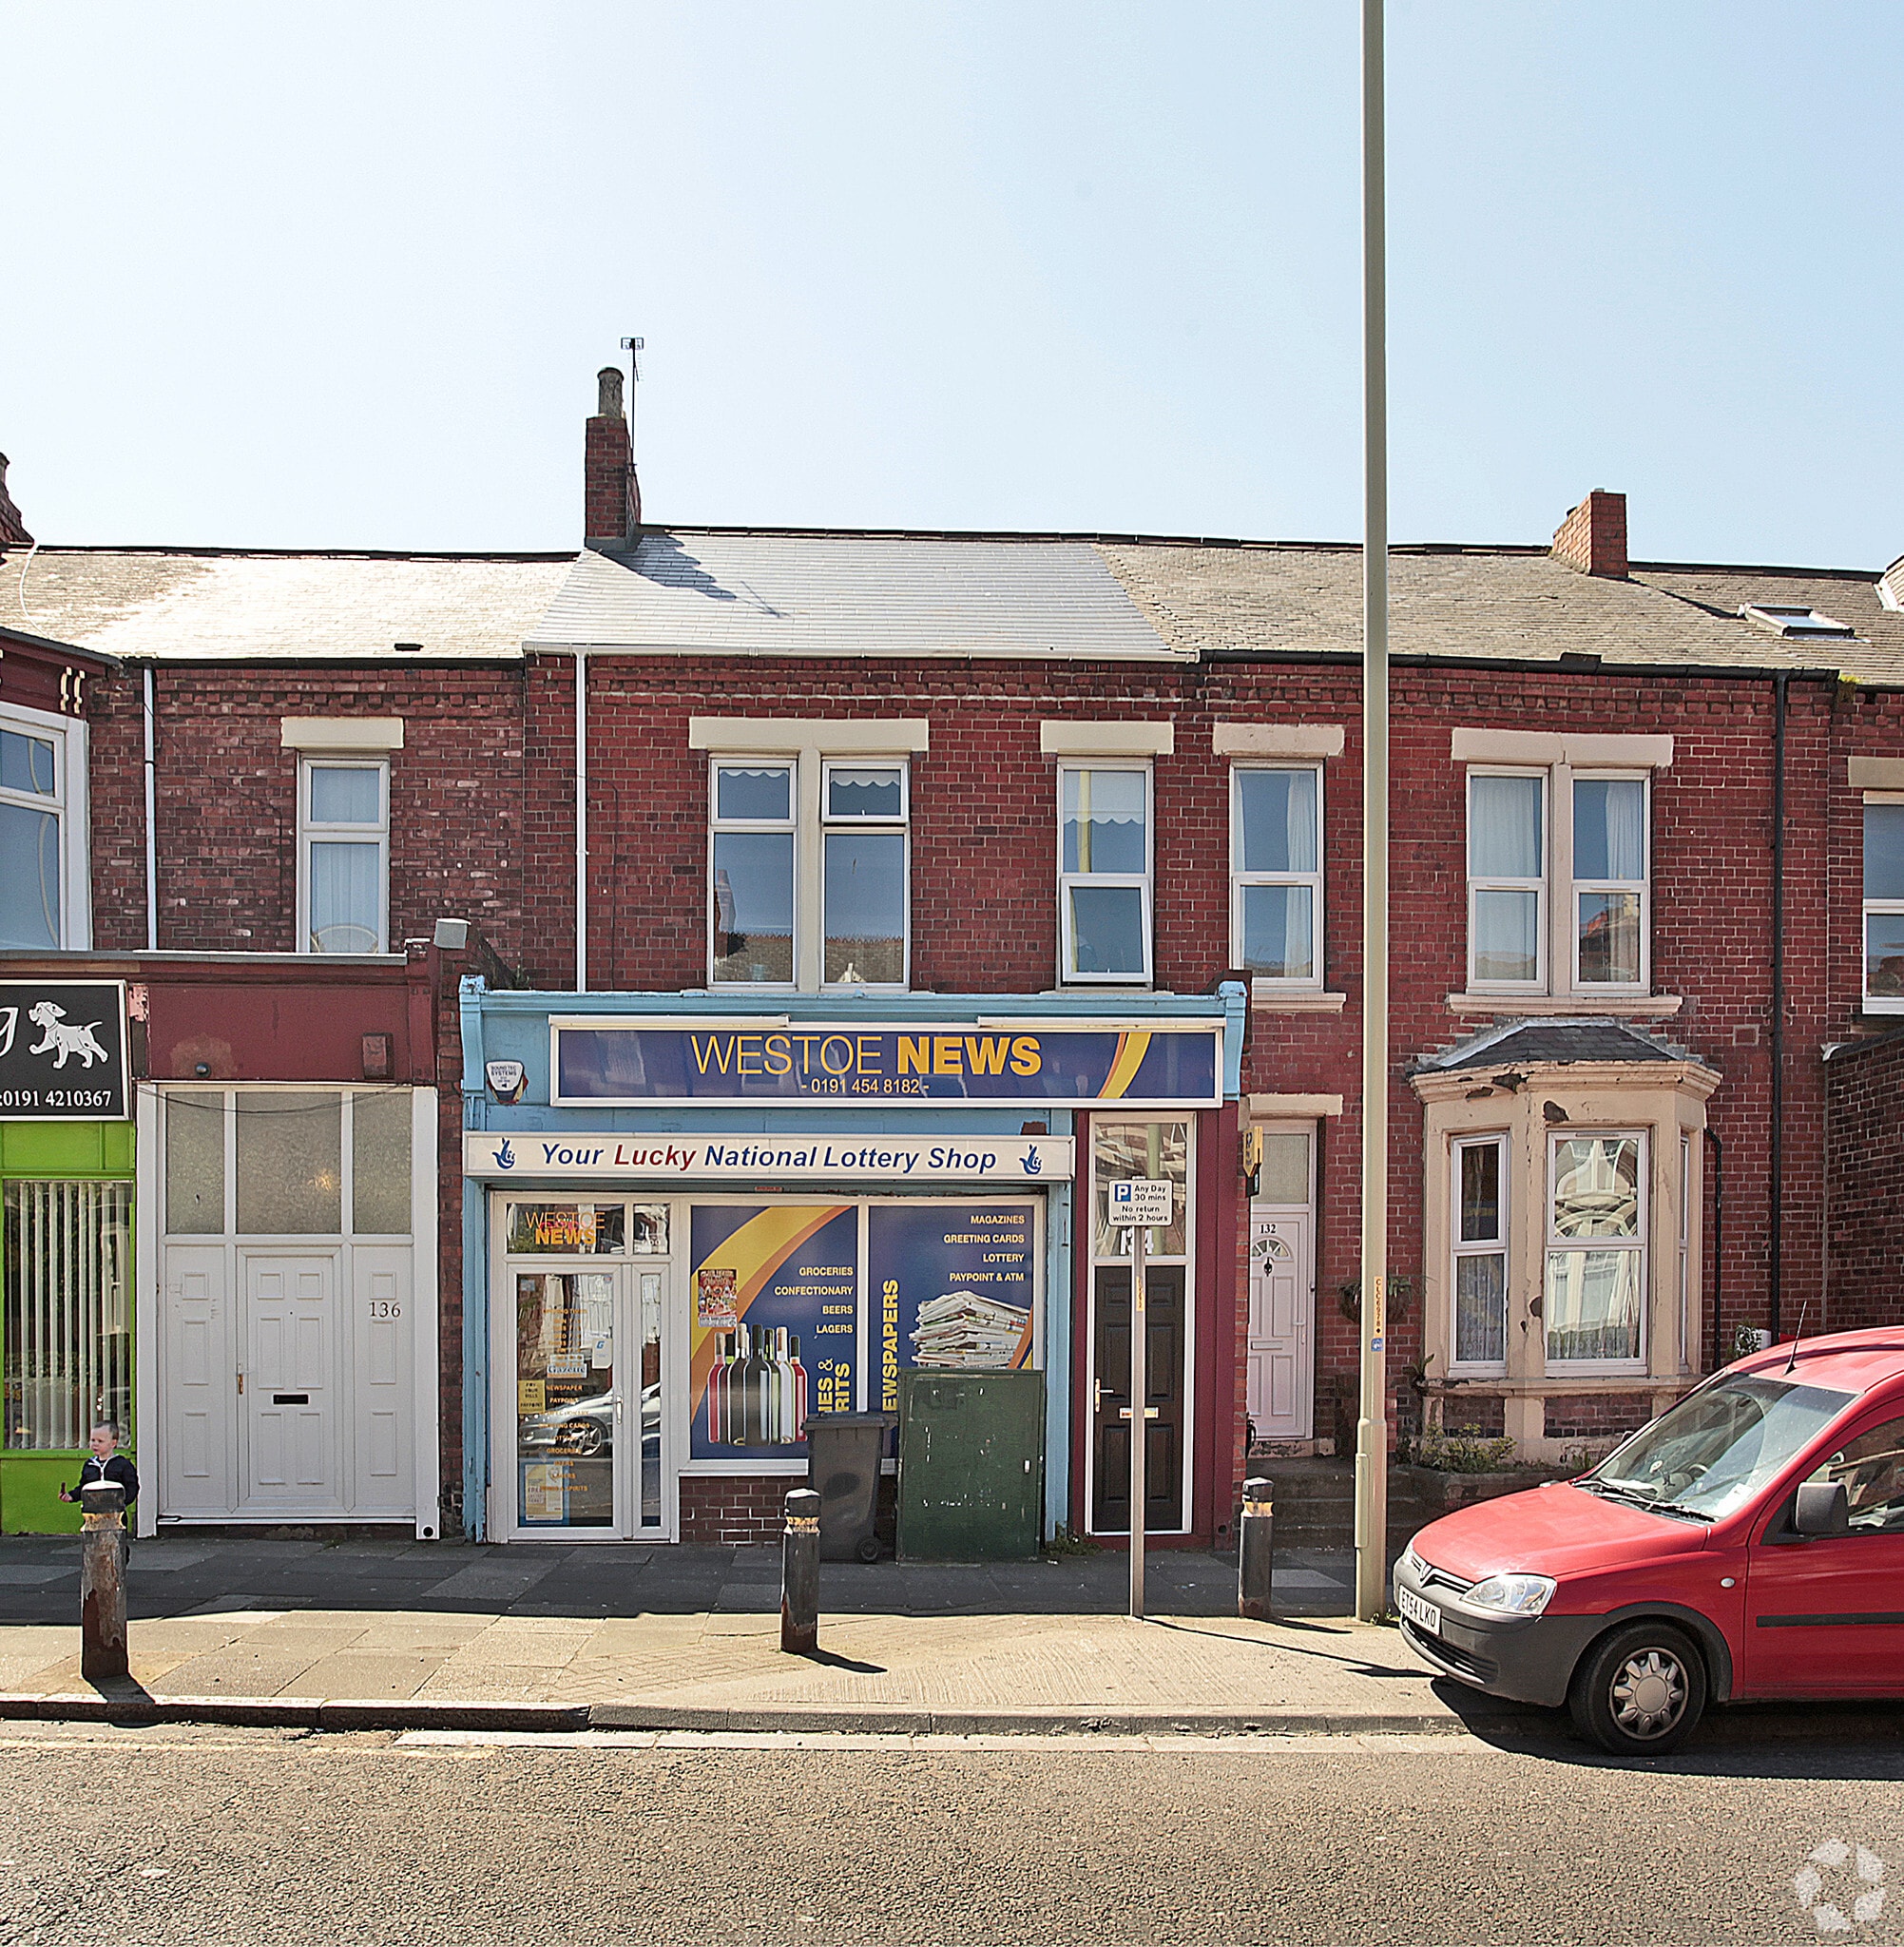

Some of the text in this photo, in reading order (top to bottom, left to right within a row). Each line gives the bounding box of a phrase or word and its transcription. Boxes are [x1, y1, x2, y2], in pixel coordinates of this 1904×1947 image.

[691, 1034, 1042, 1076] WESTOE NEWS
[812, 1078, 847, 1094] 0191
[852, 1078, 879, 1094] 454
[883, 1078, 920, 1094] 8182
[46, 1089, 112, 1107] 4210367
[542, 1143, 997, 1175] Your Lucky National Lottery Shop
[1135, 1185, 1166, 1194] Any Day
[525, 1211, 606, 1229] WESTOE
[971, 1215, 1025, 1224] MAGAZINES
[1260, 1224, 1277, 1234] 132
[535, 1228, 596, 1245] NEWS
[943, 1234, 1025, 1243] GREETING CARDS
[983, 1253, 1025, 1263] LOTTERY
[799, 1267, 854, 1276] GROCERIES
[950, 1273, 1025, 1282] PAYPOINT & ATM
[774, 1286, 854, 1296] CONFECTIONARY
[369, 1301, 402, 1319] 136
[822, 1305, 854, 1315] BEERS
[816, 1324, 854, 1334] LAGERS
[882, 1280, 898, 1412] EWSPAPERS
[835, 1362, 851, 1412] RITS
